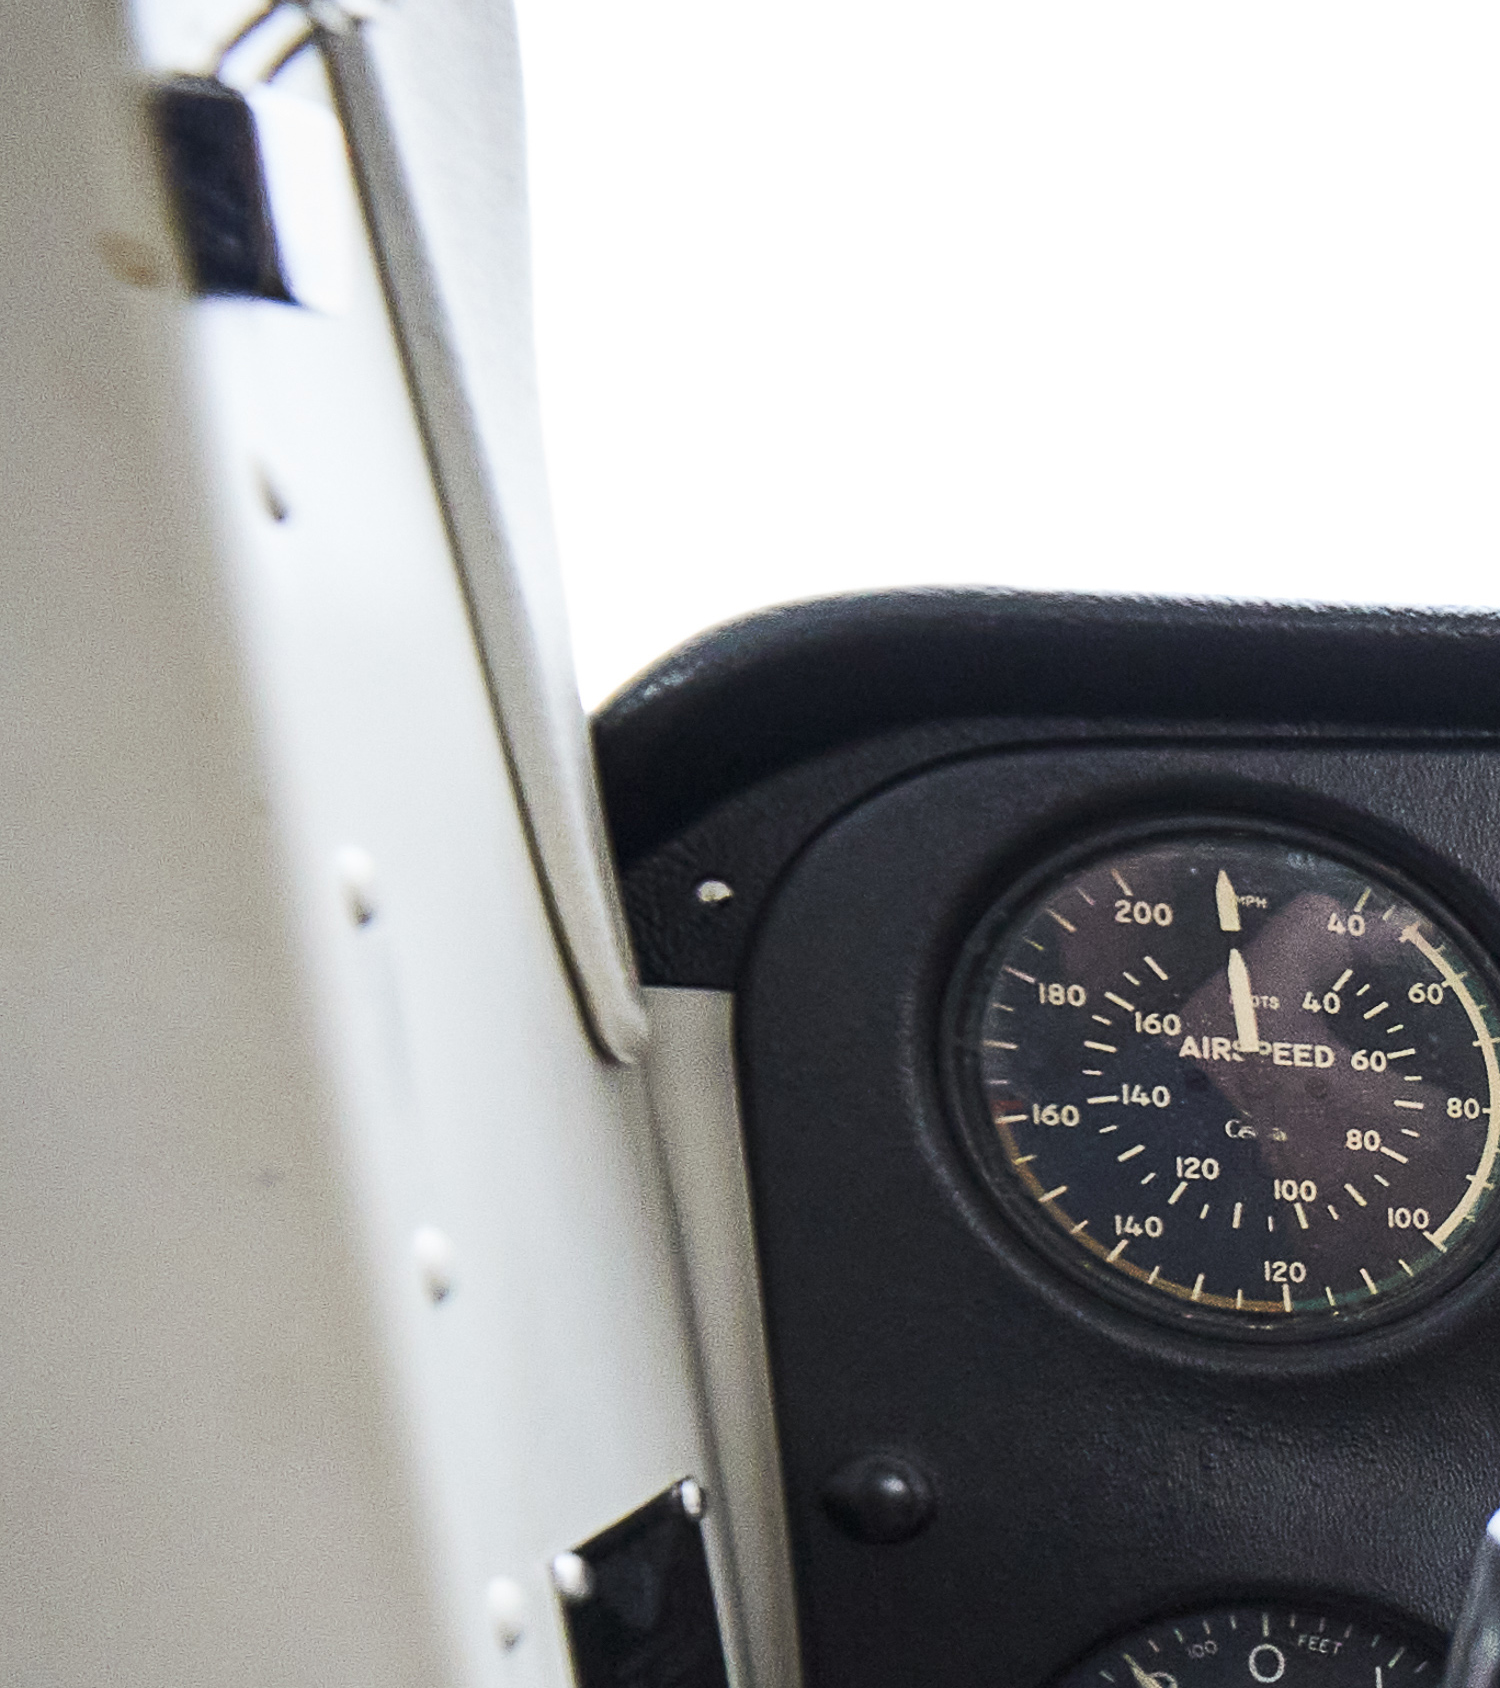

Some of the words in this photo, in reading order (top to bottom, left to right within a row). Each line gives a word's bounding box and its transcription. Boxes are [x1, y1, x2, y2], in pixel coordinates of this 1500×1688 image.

[1115, 901, 1172, 927] 200
[1327, 914, 1365, 937] 40
[1038, 983, 1086, 1006] 180
[1302, 992, 1340, 1016] 40
[1408, 982, 1444, 1005] 60
[1134, 1012, 1181, 1036] 160
[1351, 1049, 1386, 1072] 60
[1121, 1084, 1170, 1108] 140
[1032, 1103, 1079, 1126] 160
[1447, 1097, 1479, 1119] 80
[1346, 1129, 1381, 1152] 80
[1176, 1158, 1219, 1180] 120
[1273, 1180, 1317, 1201] 100
[1114, 1214, 1163, 1238] 140
[1386, 1207, 1429, 1229] 100
[1264, 1261, 1307, 1283] 120
[1299, 1636, 1342, 1654] FEET
[1249, 1644, 1285, 1683] 0
